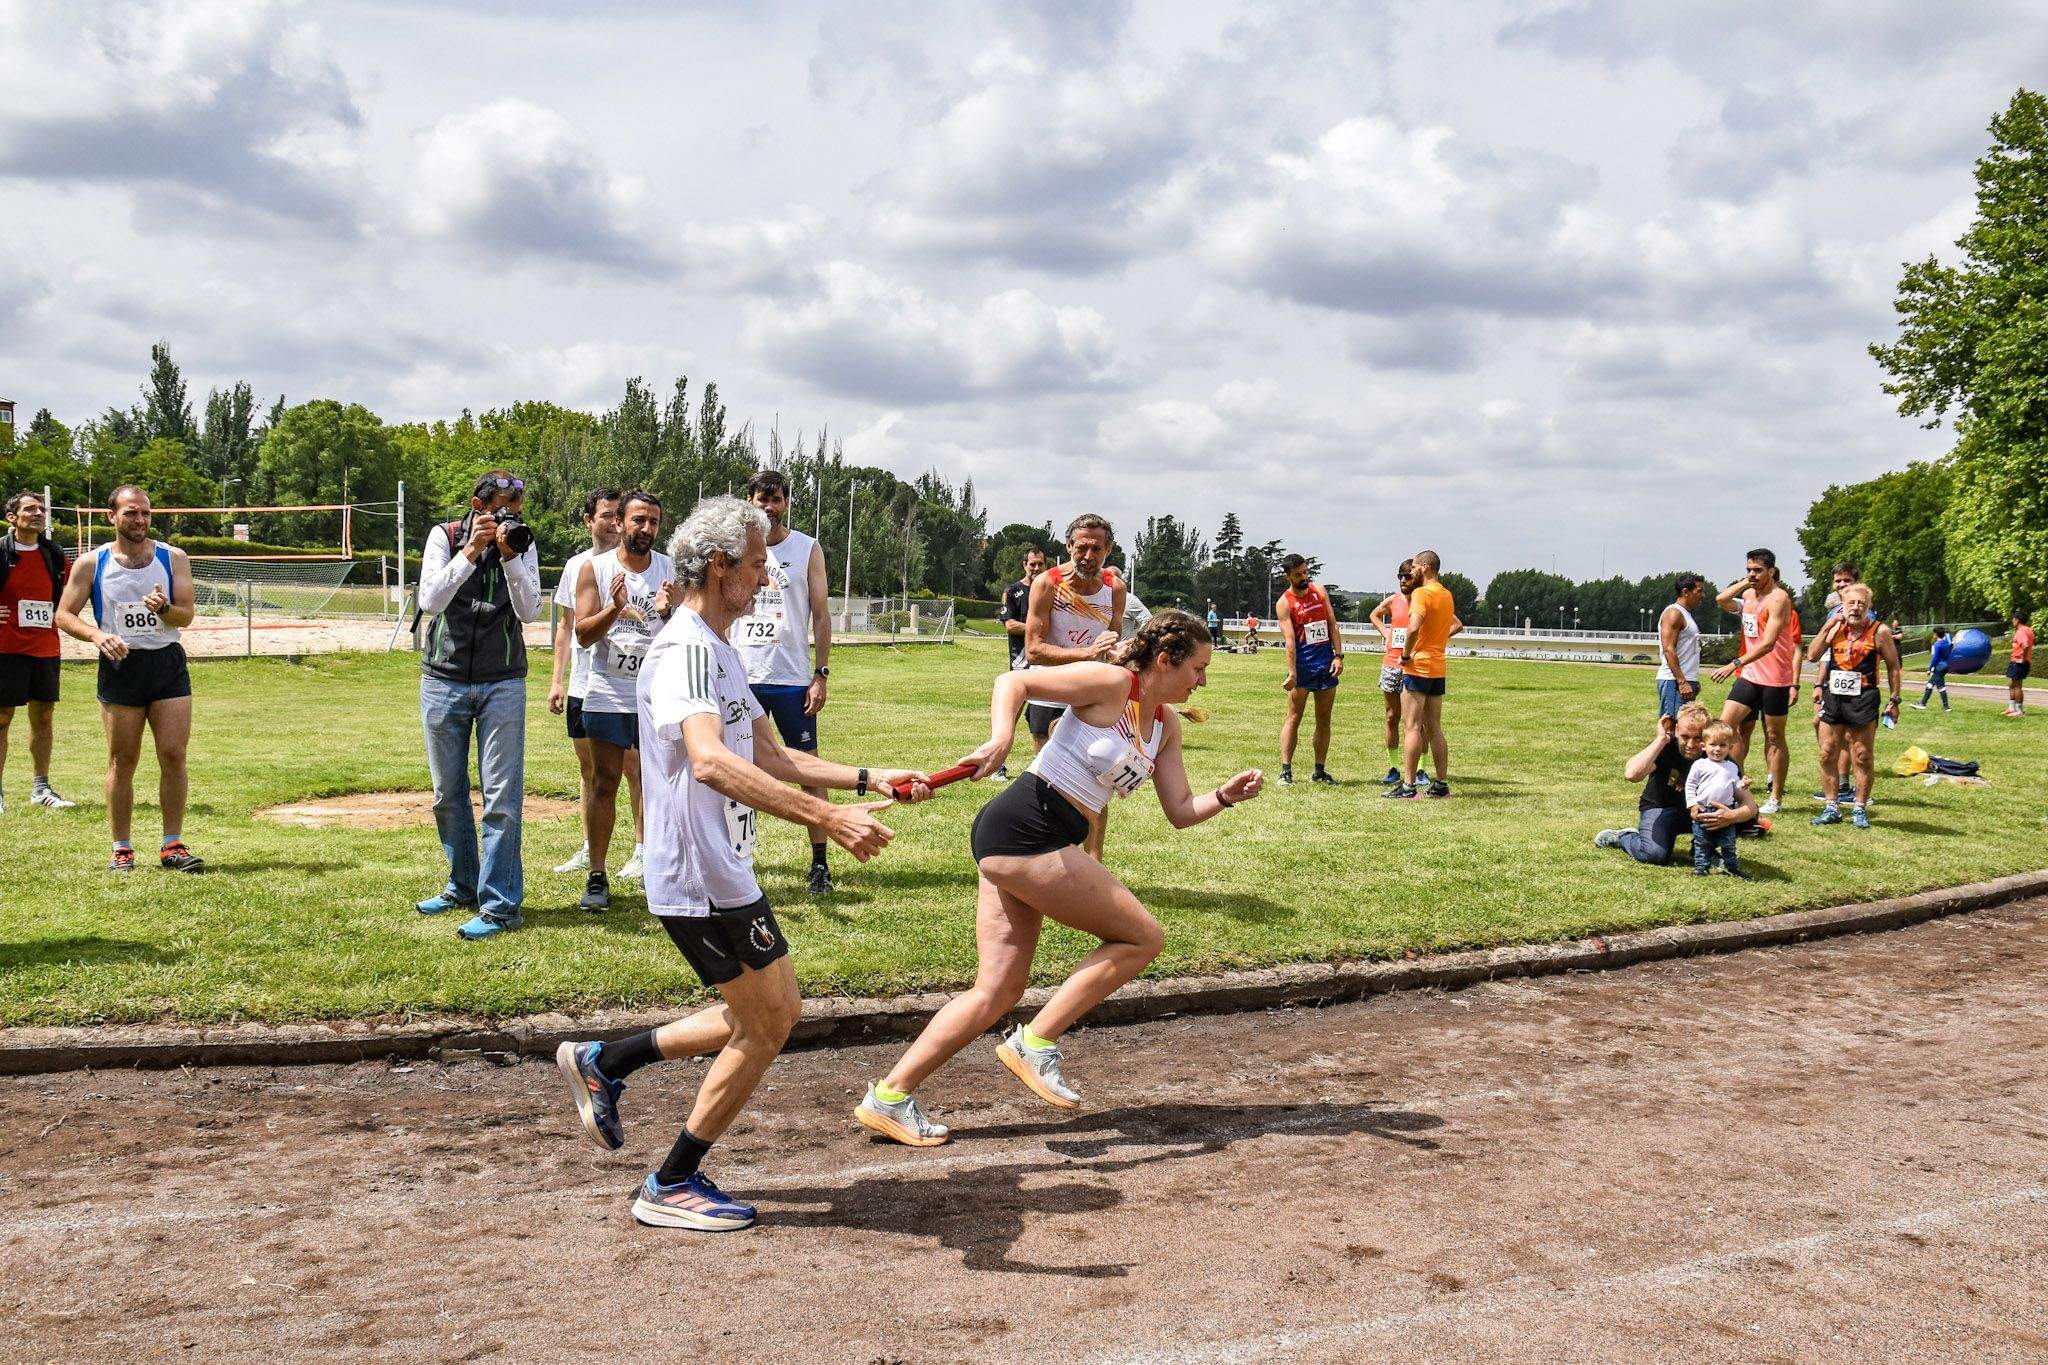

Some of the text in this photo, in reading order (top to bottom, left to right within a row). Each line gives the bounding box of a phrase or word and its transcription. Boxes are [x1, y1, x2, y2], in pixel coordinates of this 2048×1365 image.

[25, 609, 49, 621] 818
[632, 596, 657, 622] MONICA
[125, 612, 157, 628] 886
[746, 623, 775, 637] 732
[1310, 627, 1326, 639] 743
[1554, 653, 1602, 662] MADRID
[1834, 679, 1855, 689] 862
[1113, 764, 1143, 793] 774
